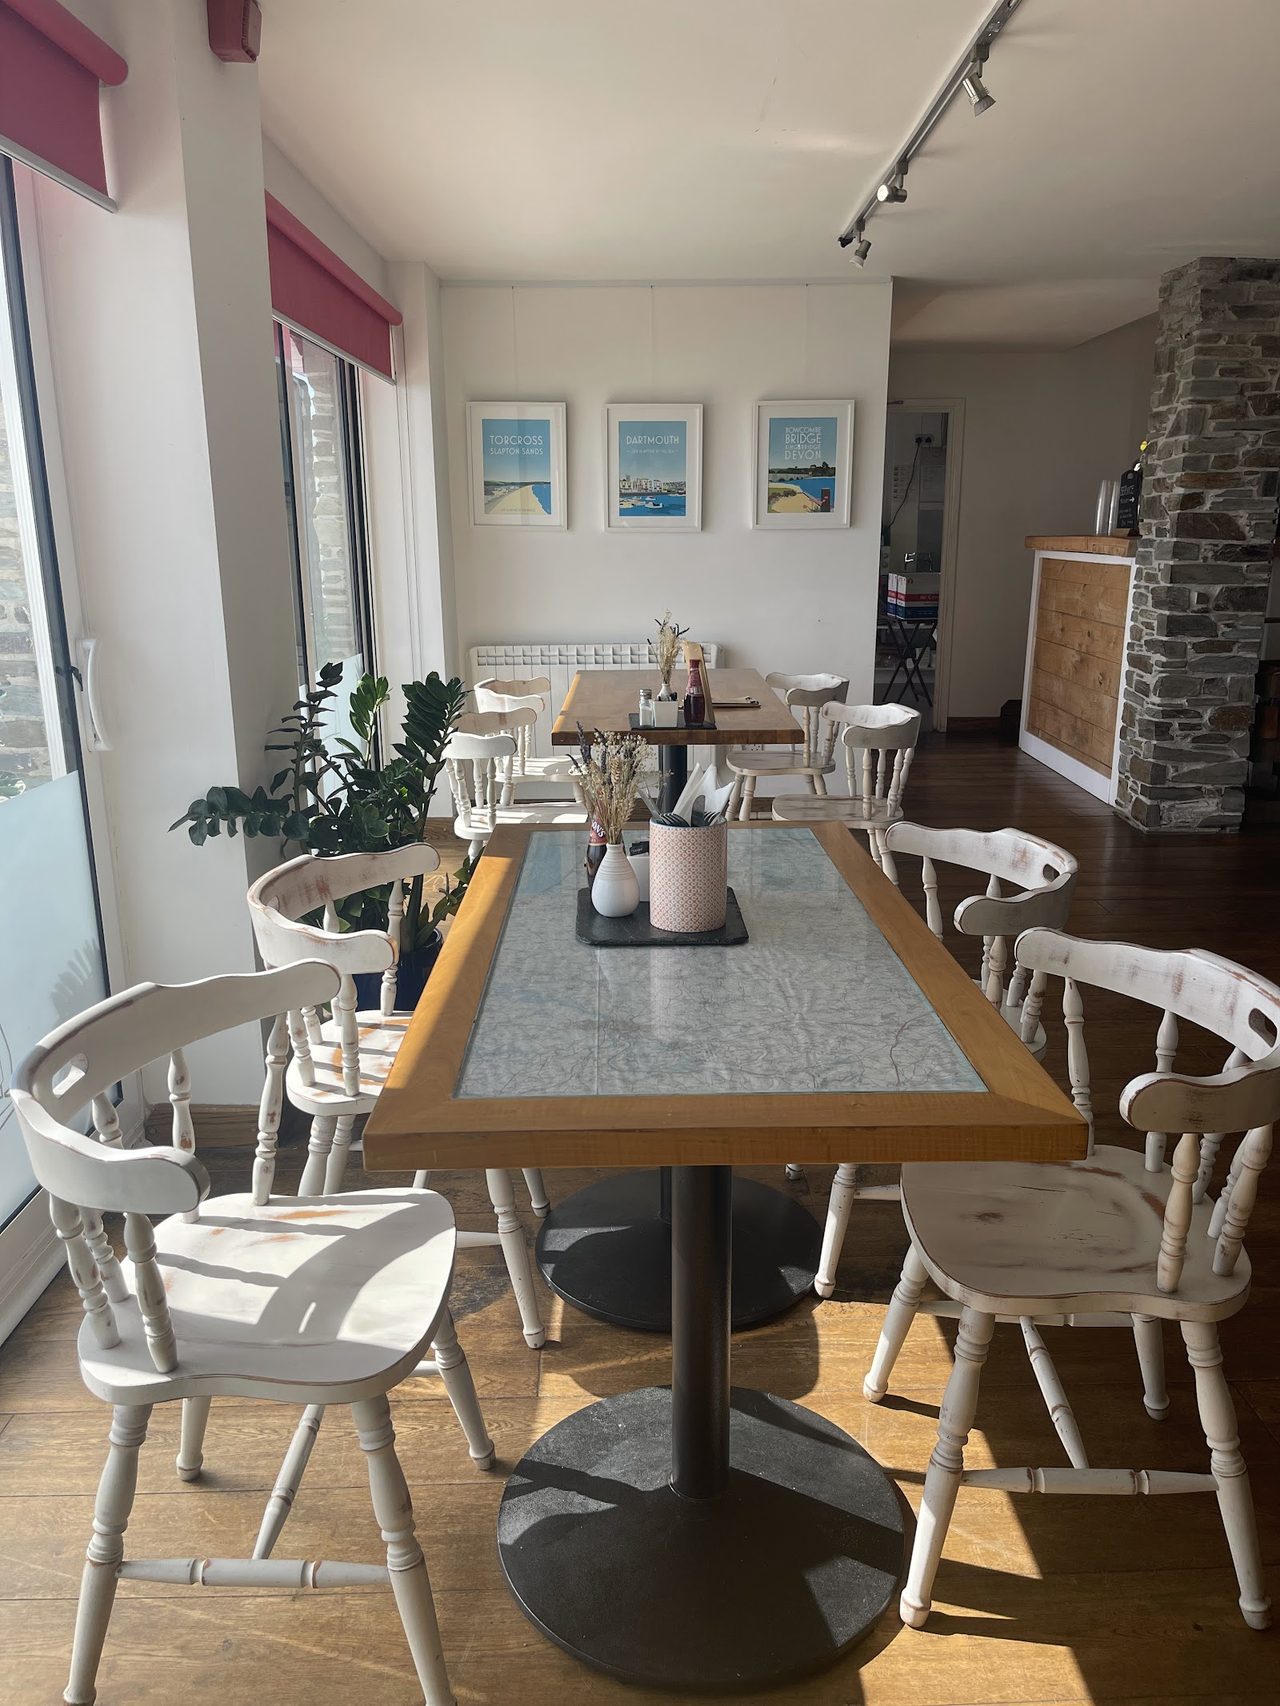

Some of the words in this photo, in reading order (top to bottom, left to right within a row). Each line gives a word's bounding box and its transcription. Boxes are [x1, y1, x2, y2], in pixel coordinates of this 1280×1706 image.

[489, 435, 543, 445] TORCROSS
[626, 435, 680, 445] DARTMOUTH
[785, 433, 822, 444] BRIDGE
[490, 447, 520, 455] SLAPTON
[522, 447, 544, 455] SANDS
[784, 450, 821, 460] DEVON
